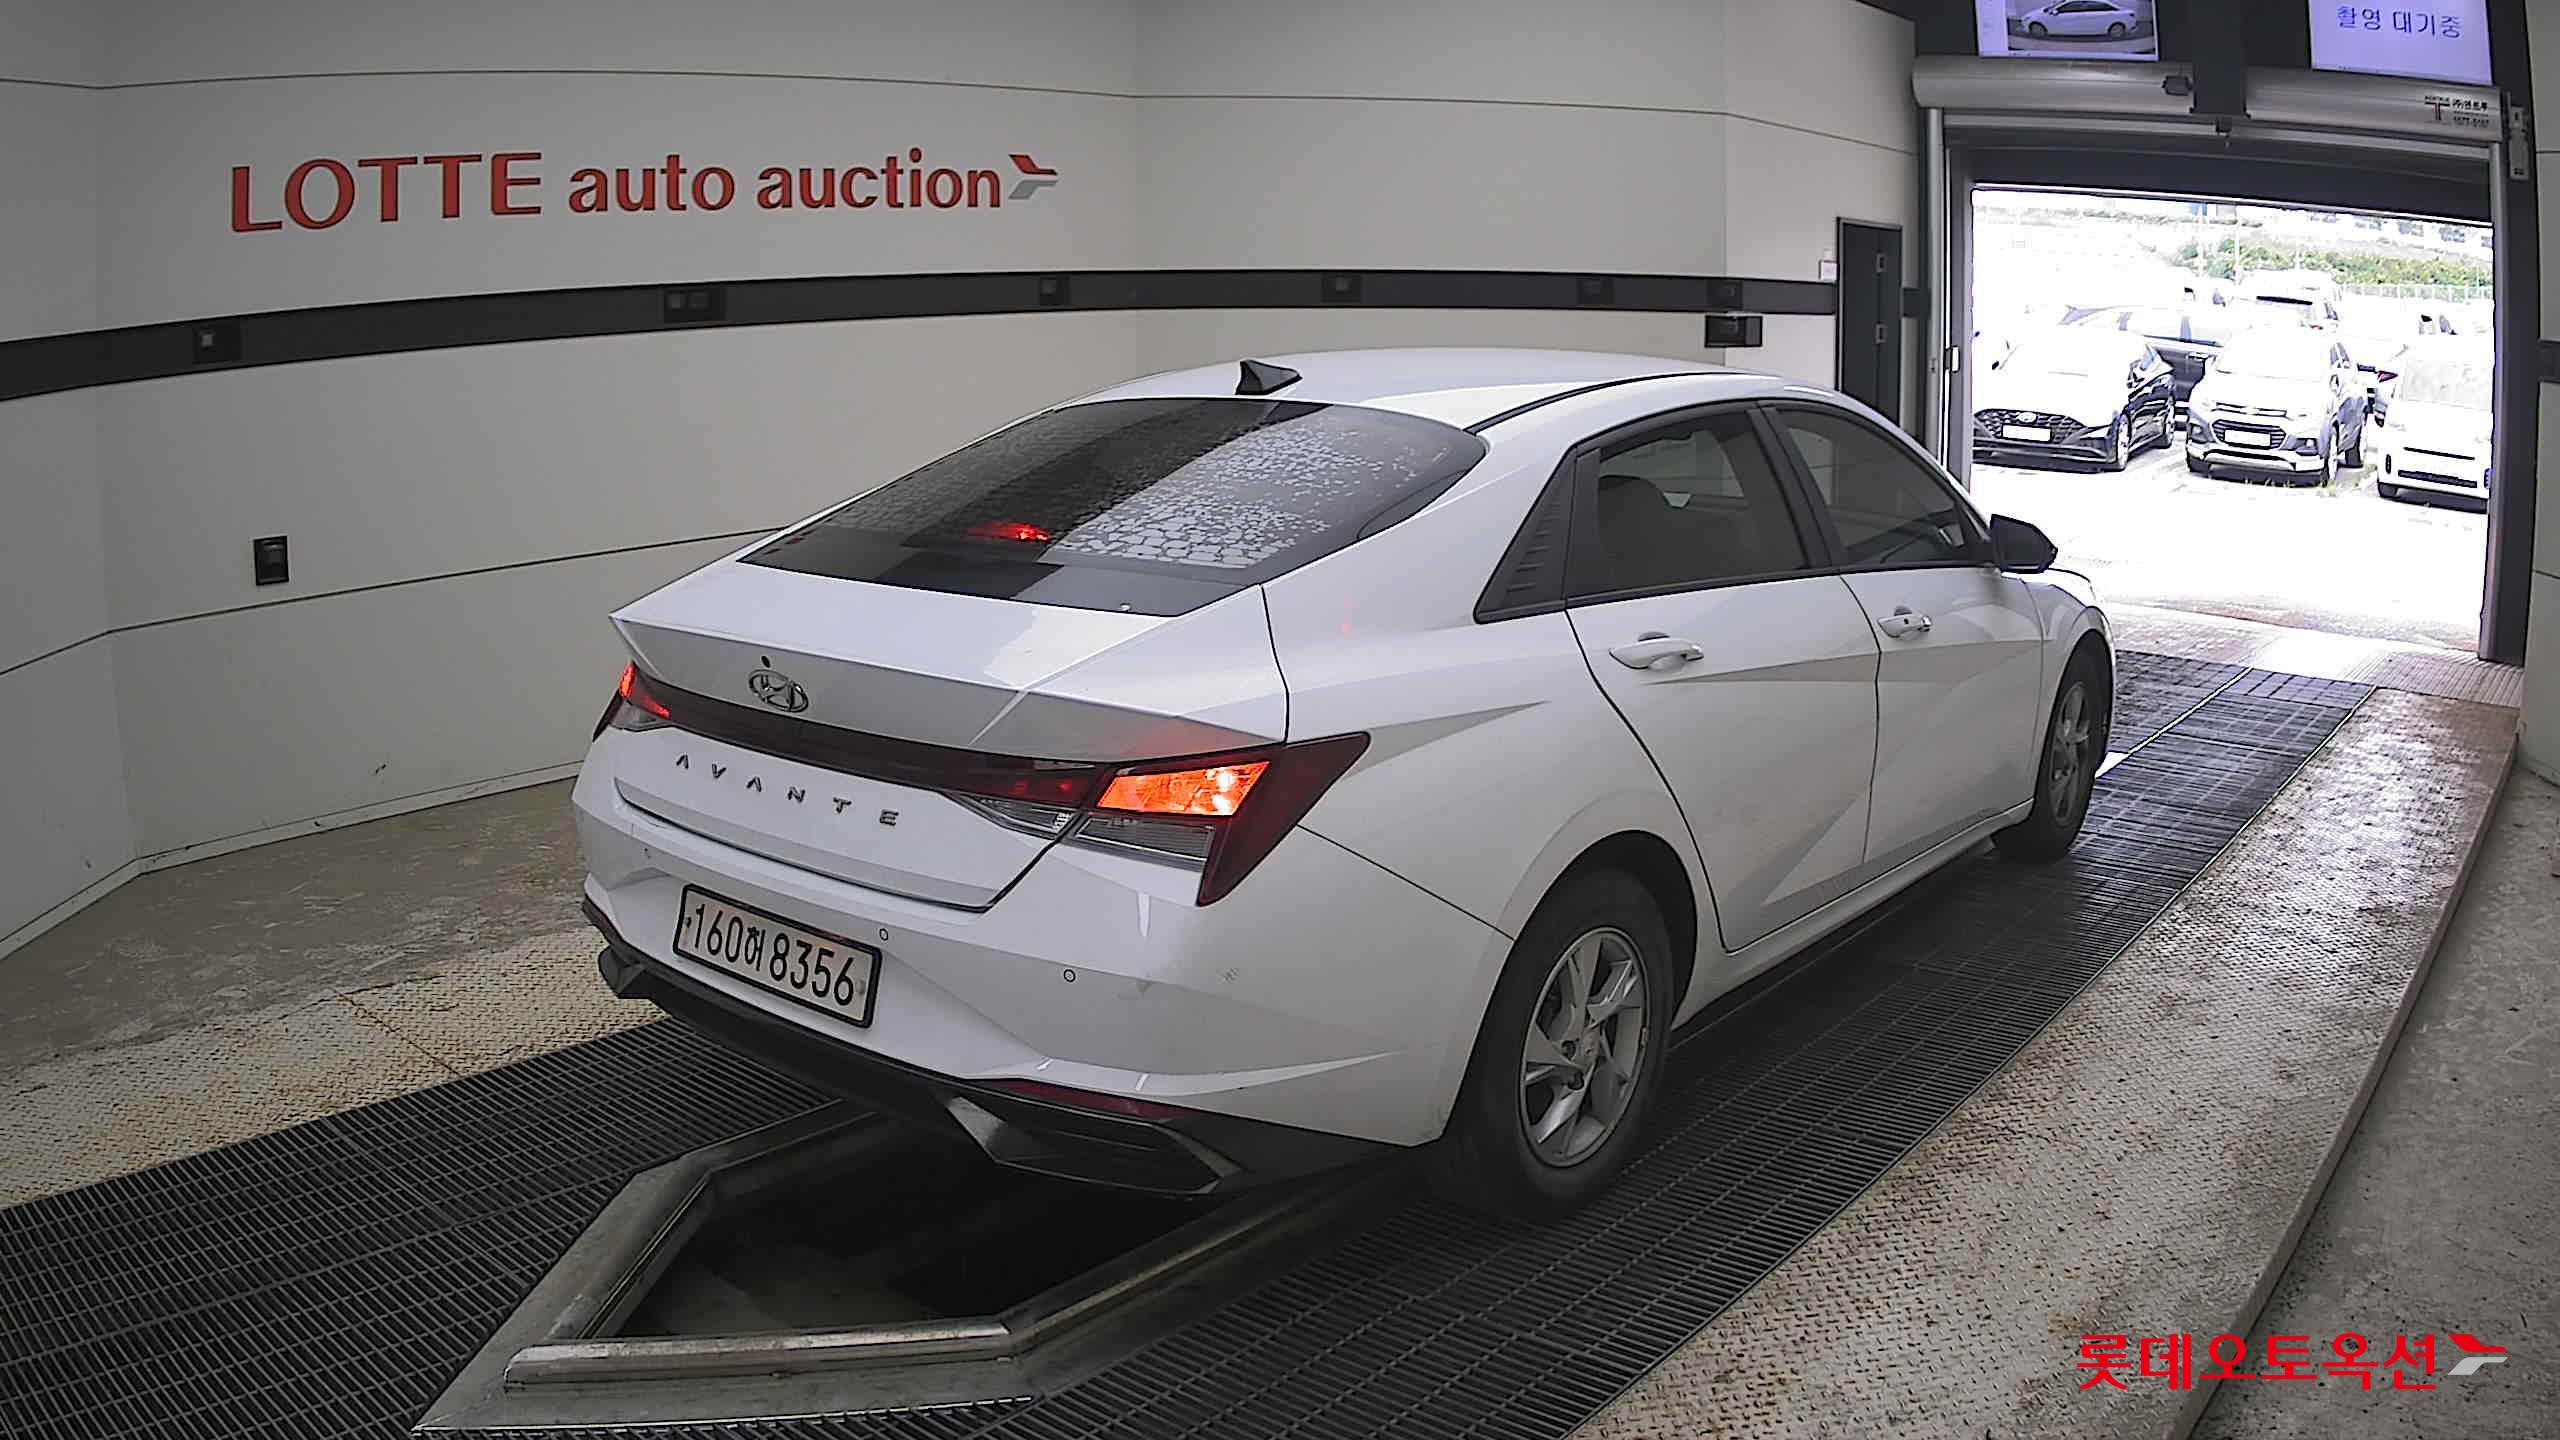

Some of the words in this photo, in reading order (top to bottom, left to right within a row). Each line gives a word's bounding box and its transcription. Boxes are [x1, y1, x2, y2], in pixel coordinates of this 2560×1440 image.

[2337, 6, 2382, 31] 촬영
[2393, 11, 2460, 39] 대기중
[230, 153, 542, 232] LOTTE
[568, 154, 736, 213] auto
[756, 147, 1001, 208] auction
[676, 754, 899, 826] AVANTE
